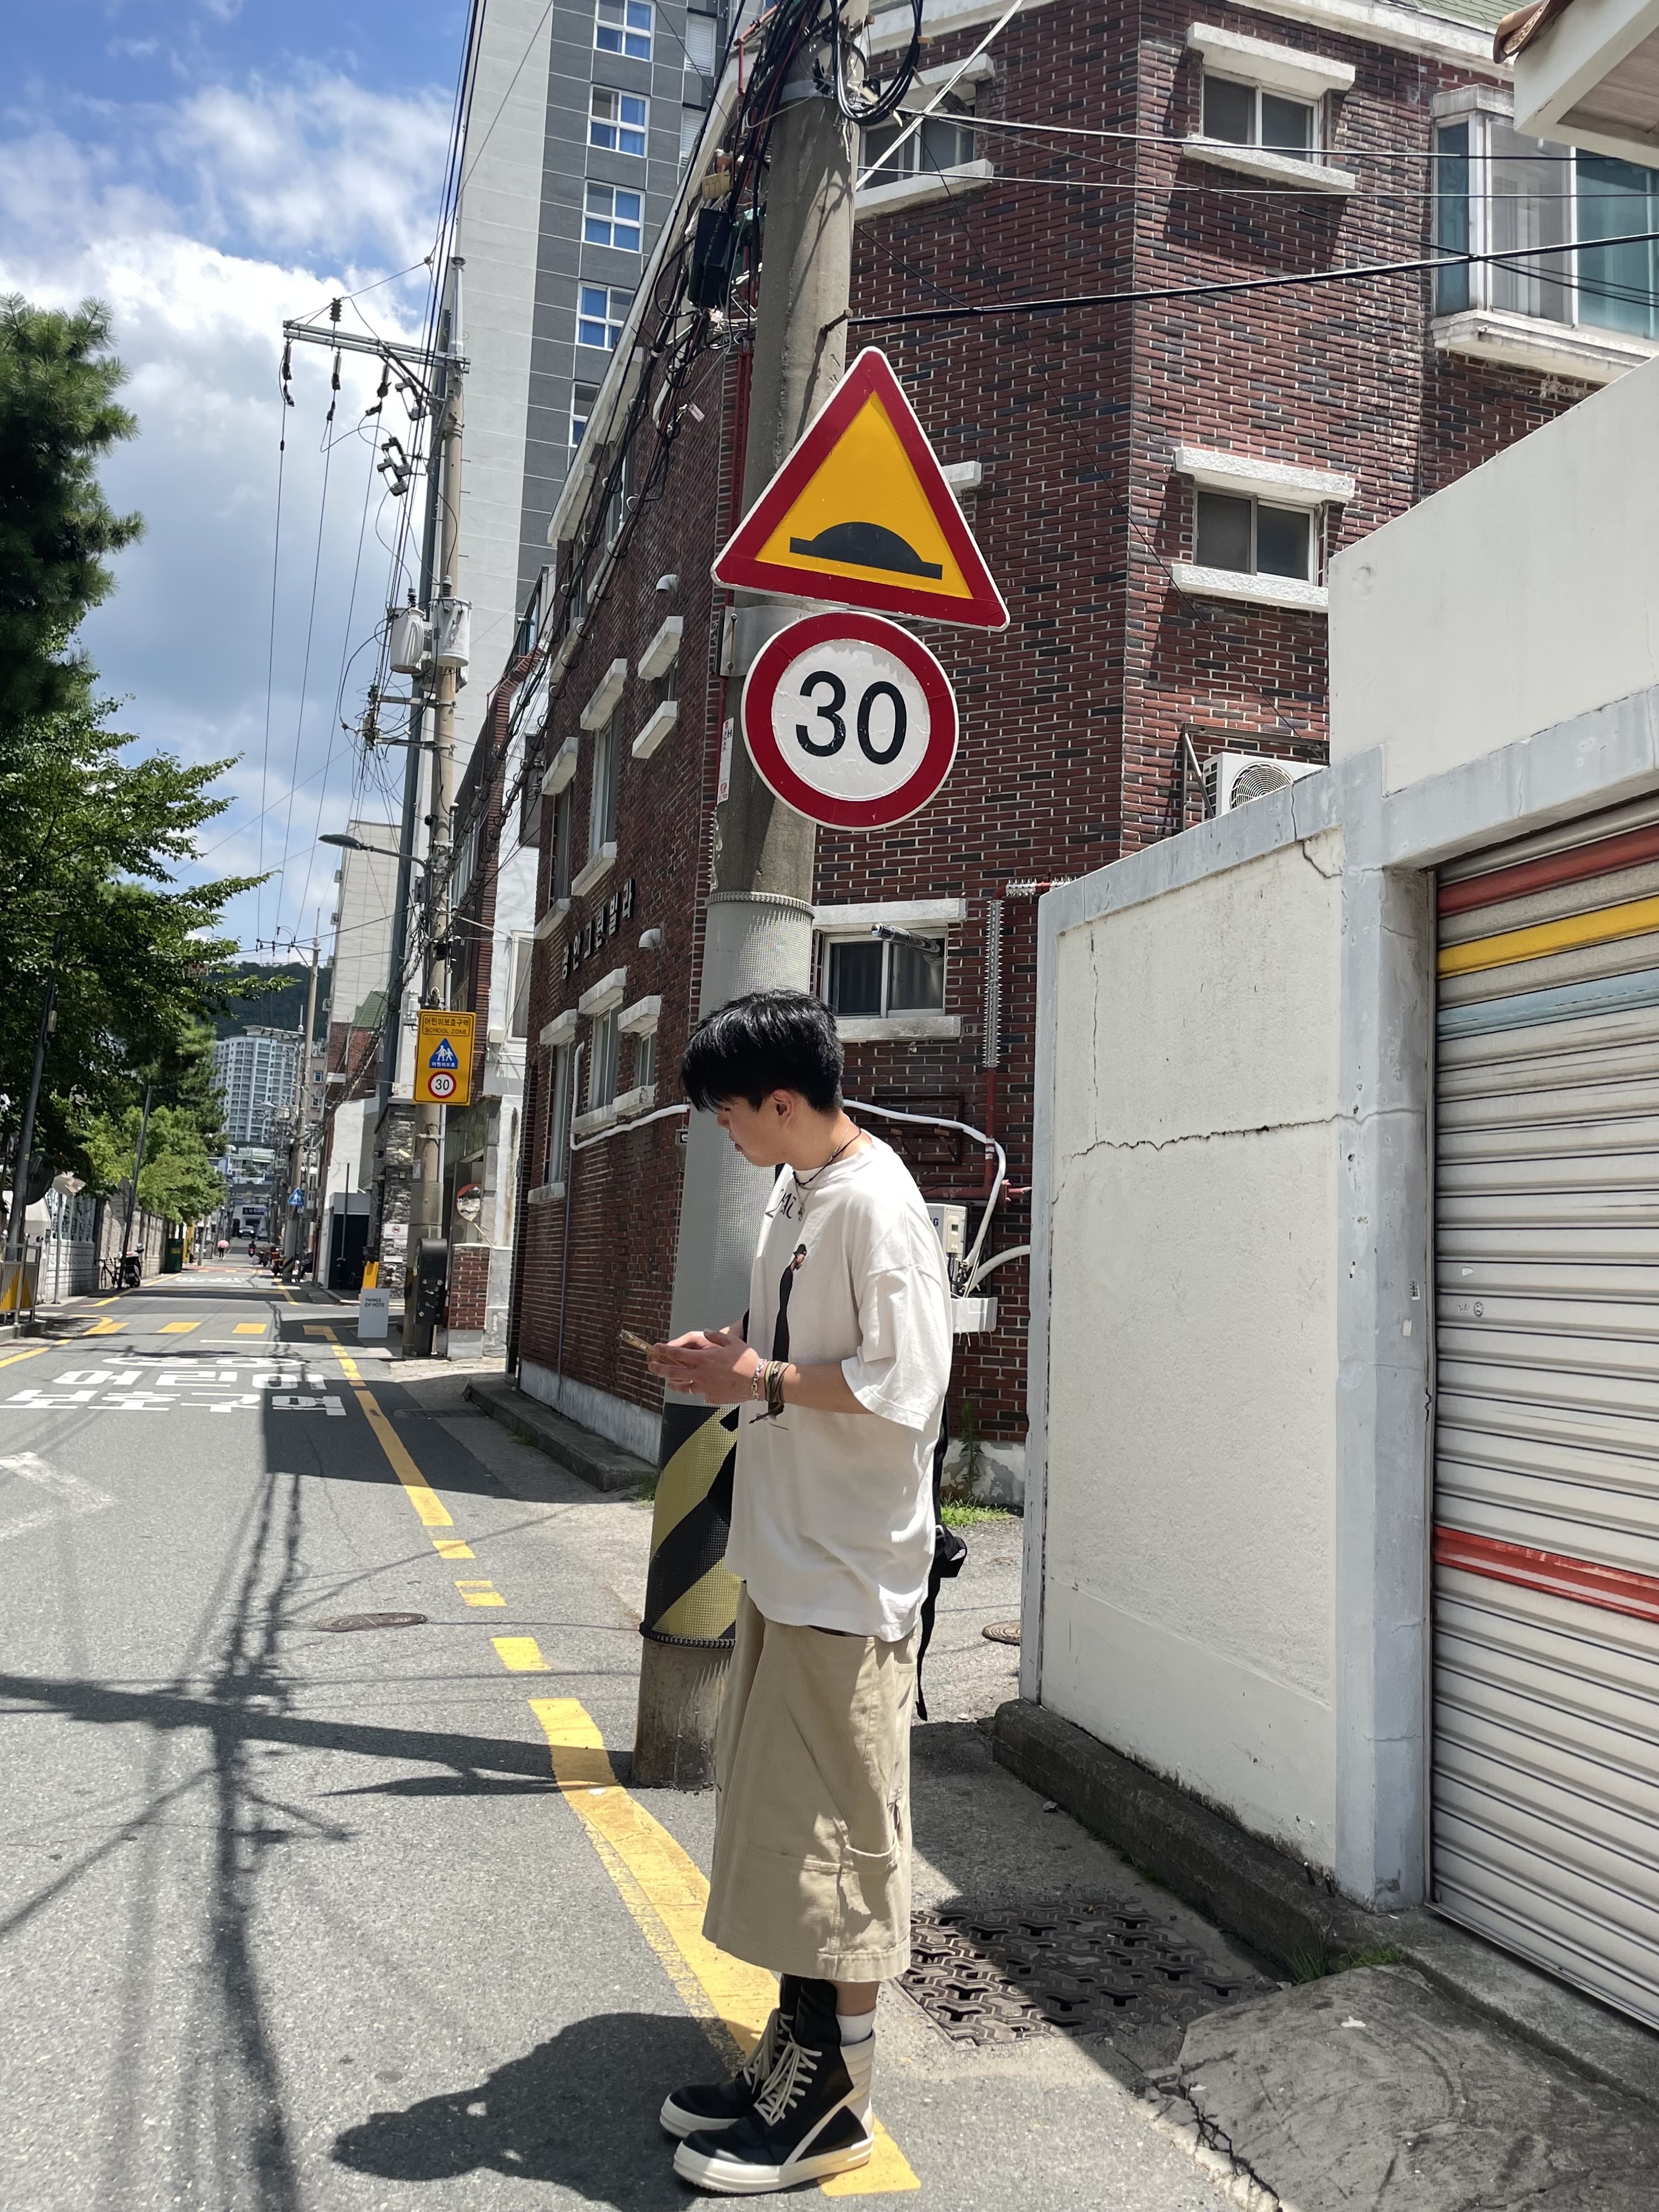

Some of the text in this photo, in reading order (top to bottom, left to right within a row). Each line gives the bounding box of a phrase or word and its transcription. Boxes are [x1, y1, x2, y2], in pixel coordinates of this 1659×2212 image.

[796, 671, 907, 765] 30
[424, 1017, 469, 1027] 어린이보호구역
[435, 1079, 449, 1090] 30
[52, 1370, 328, 1390] 어린이
[0, 1389, 347, 1416] 보호구역
